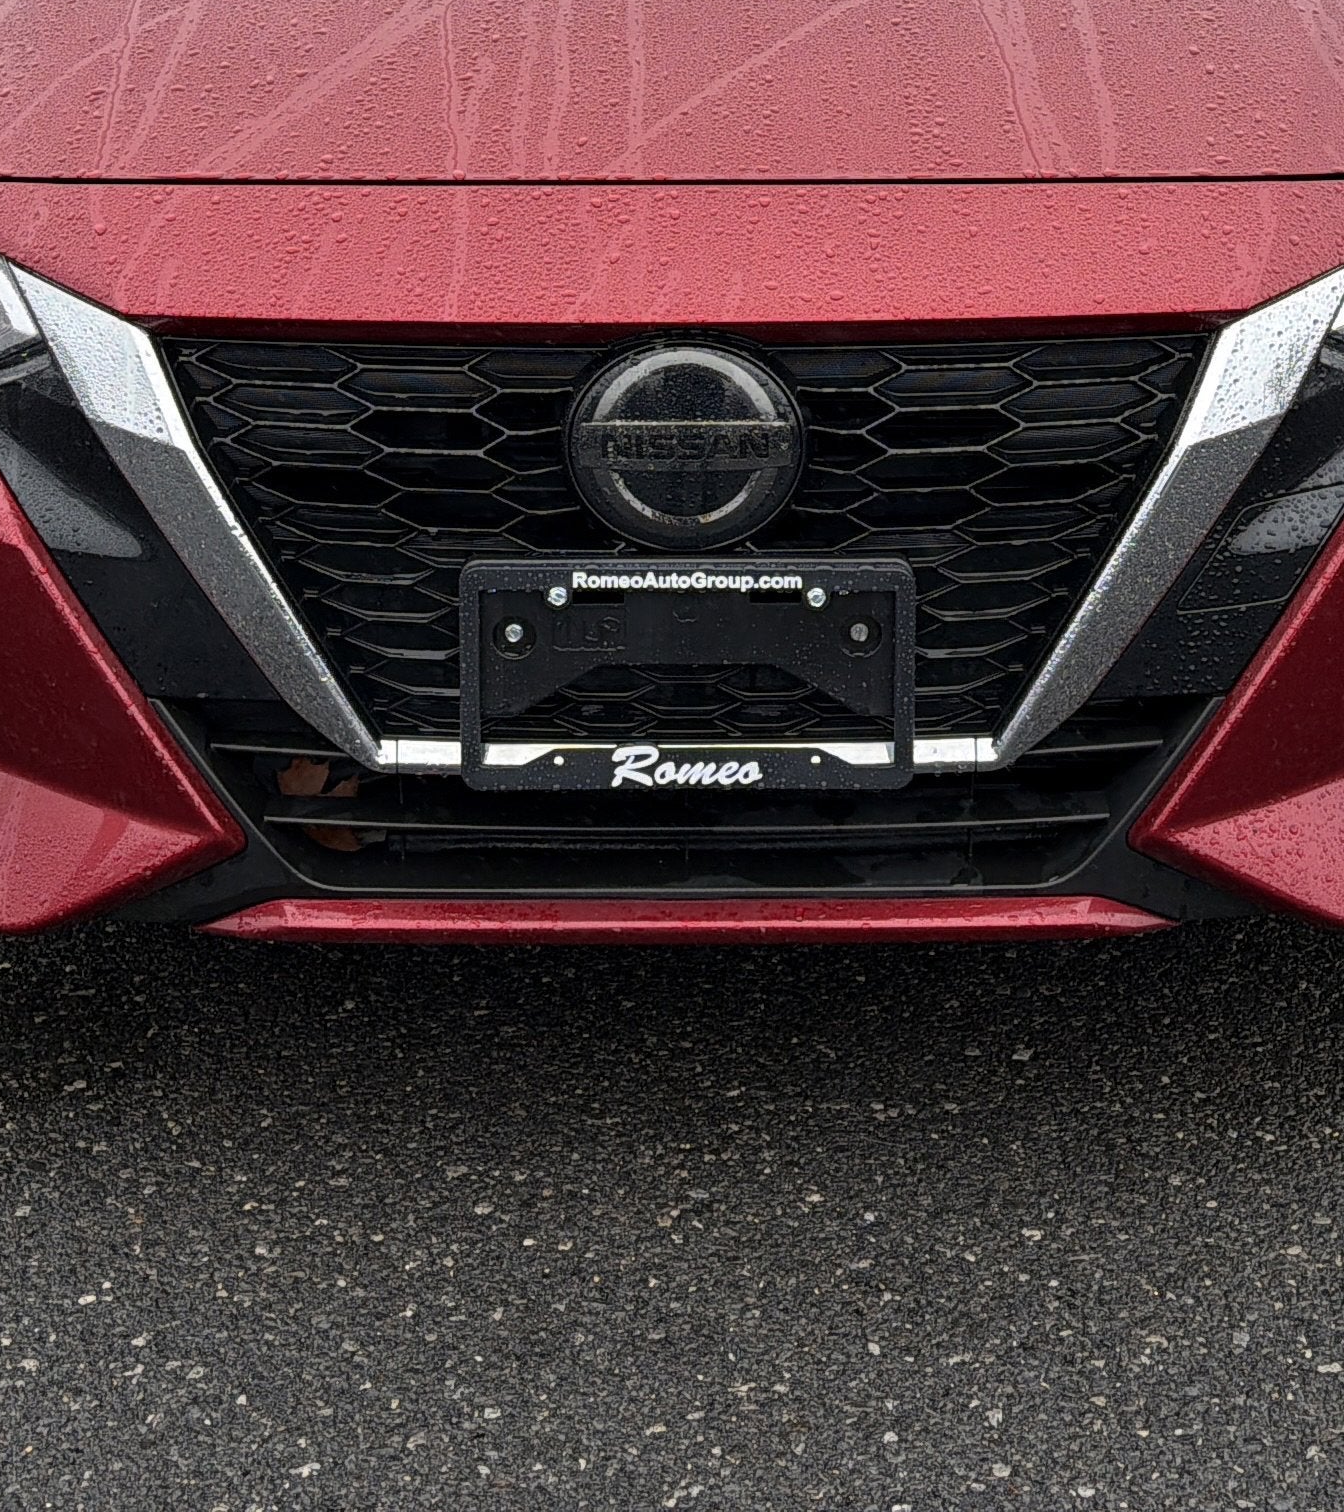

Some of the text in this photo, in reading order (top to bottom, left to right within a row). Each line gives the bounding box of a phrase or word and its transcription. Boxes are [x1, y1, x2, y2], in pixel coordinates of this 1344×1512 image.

[600, 432, 770, 461] NISSAN
[572, 571, 803, 592] RomeoAutoGroup.com
[611, 745, 763, 787] Romeo
